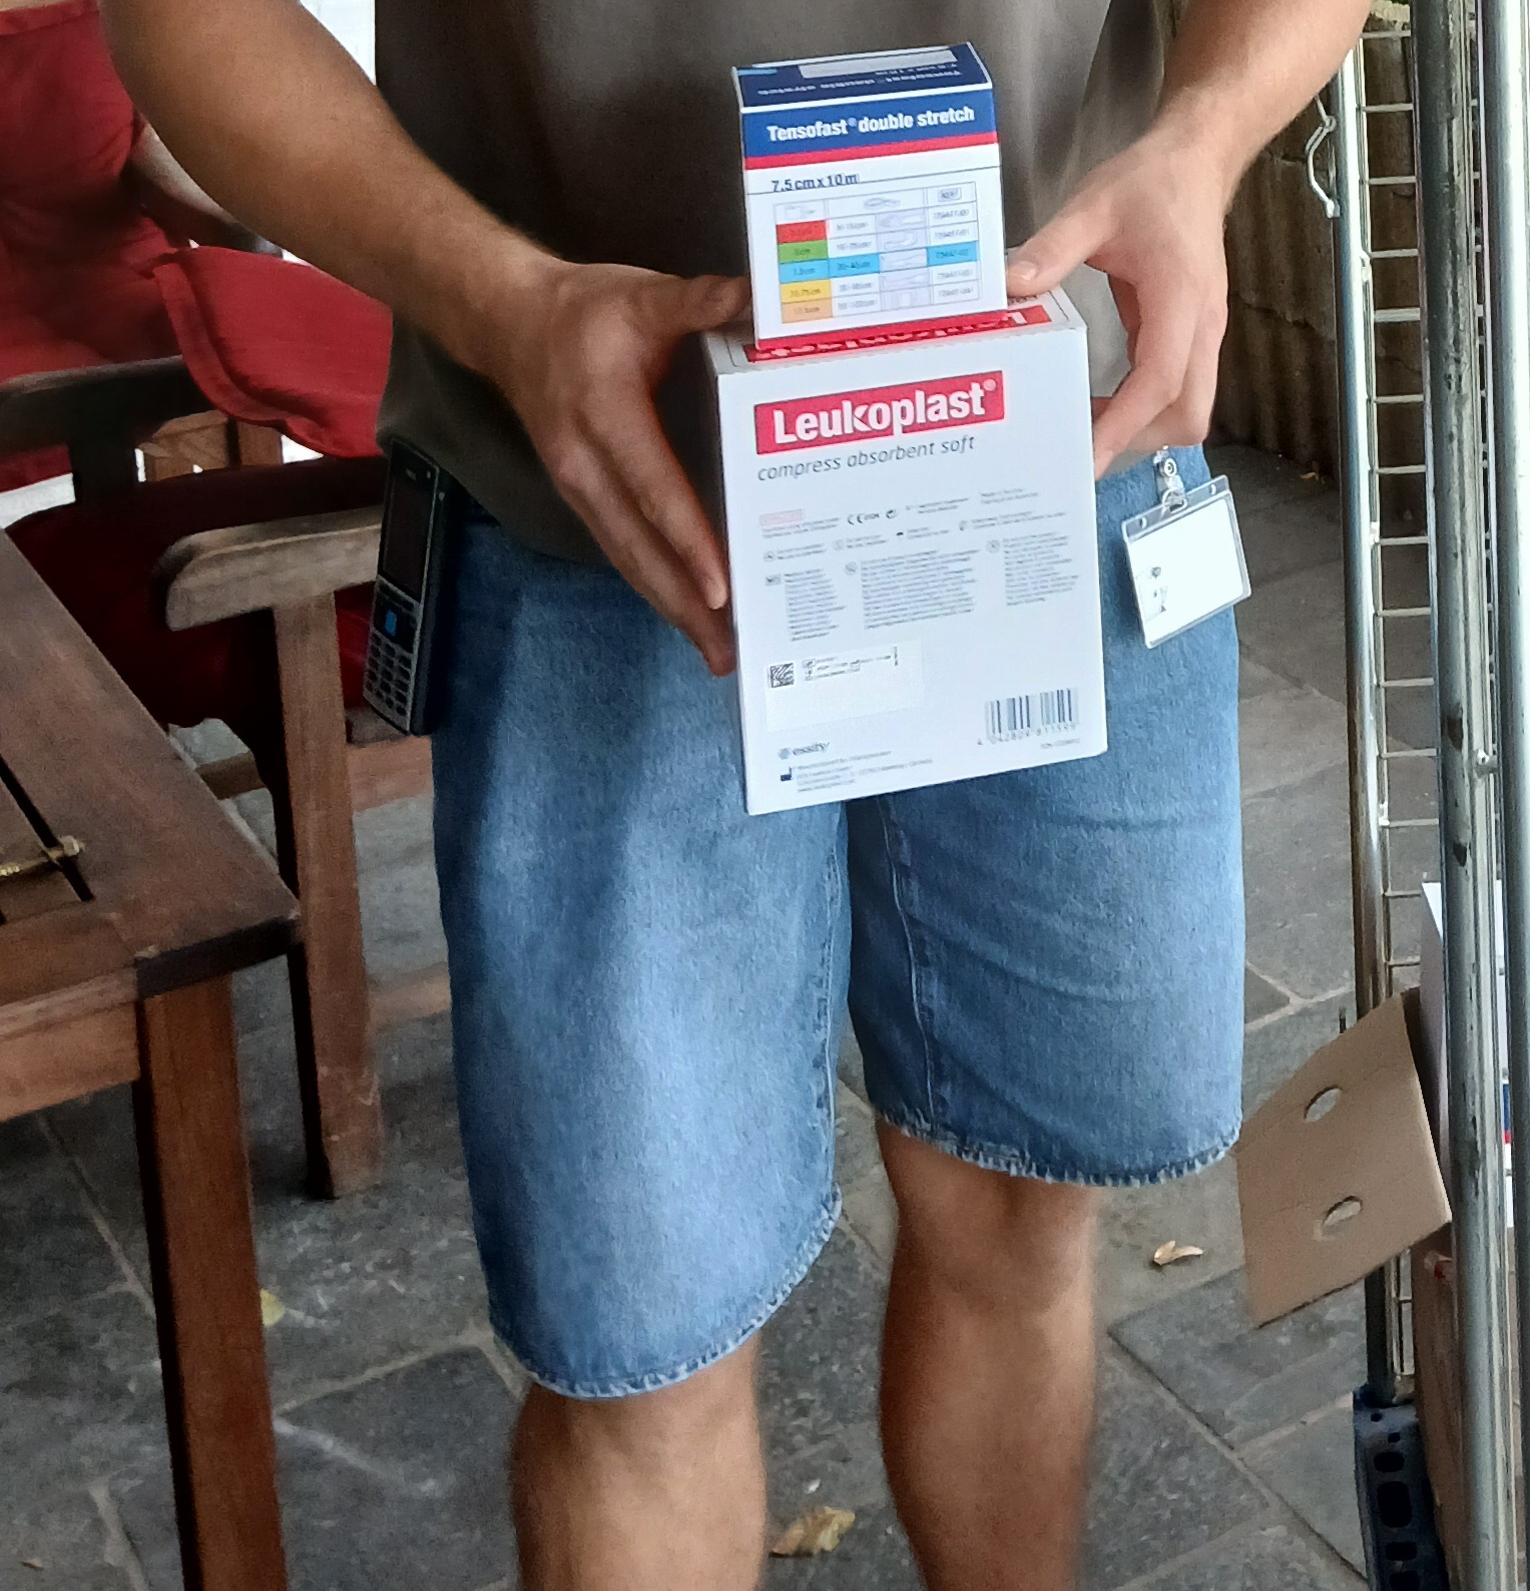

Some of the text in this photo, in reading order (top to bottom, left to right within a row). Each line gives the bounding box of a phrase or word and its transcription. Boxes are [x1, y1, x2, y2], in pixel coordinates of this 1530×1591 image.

[858, 113, 913, 133] double
[917, 106, 975, 127] stretch
[757, 434, 977, 482] compress absorbent soft
